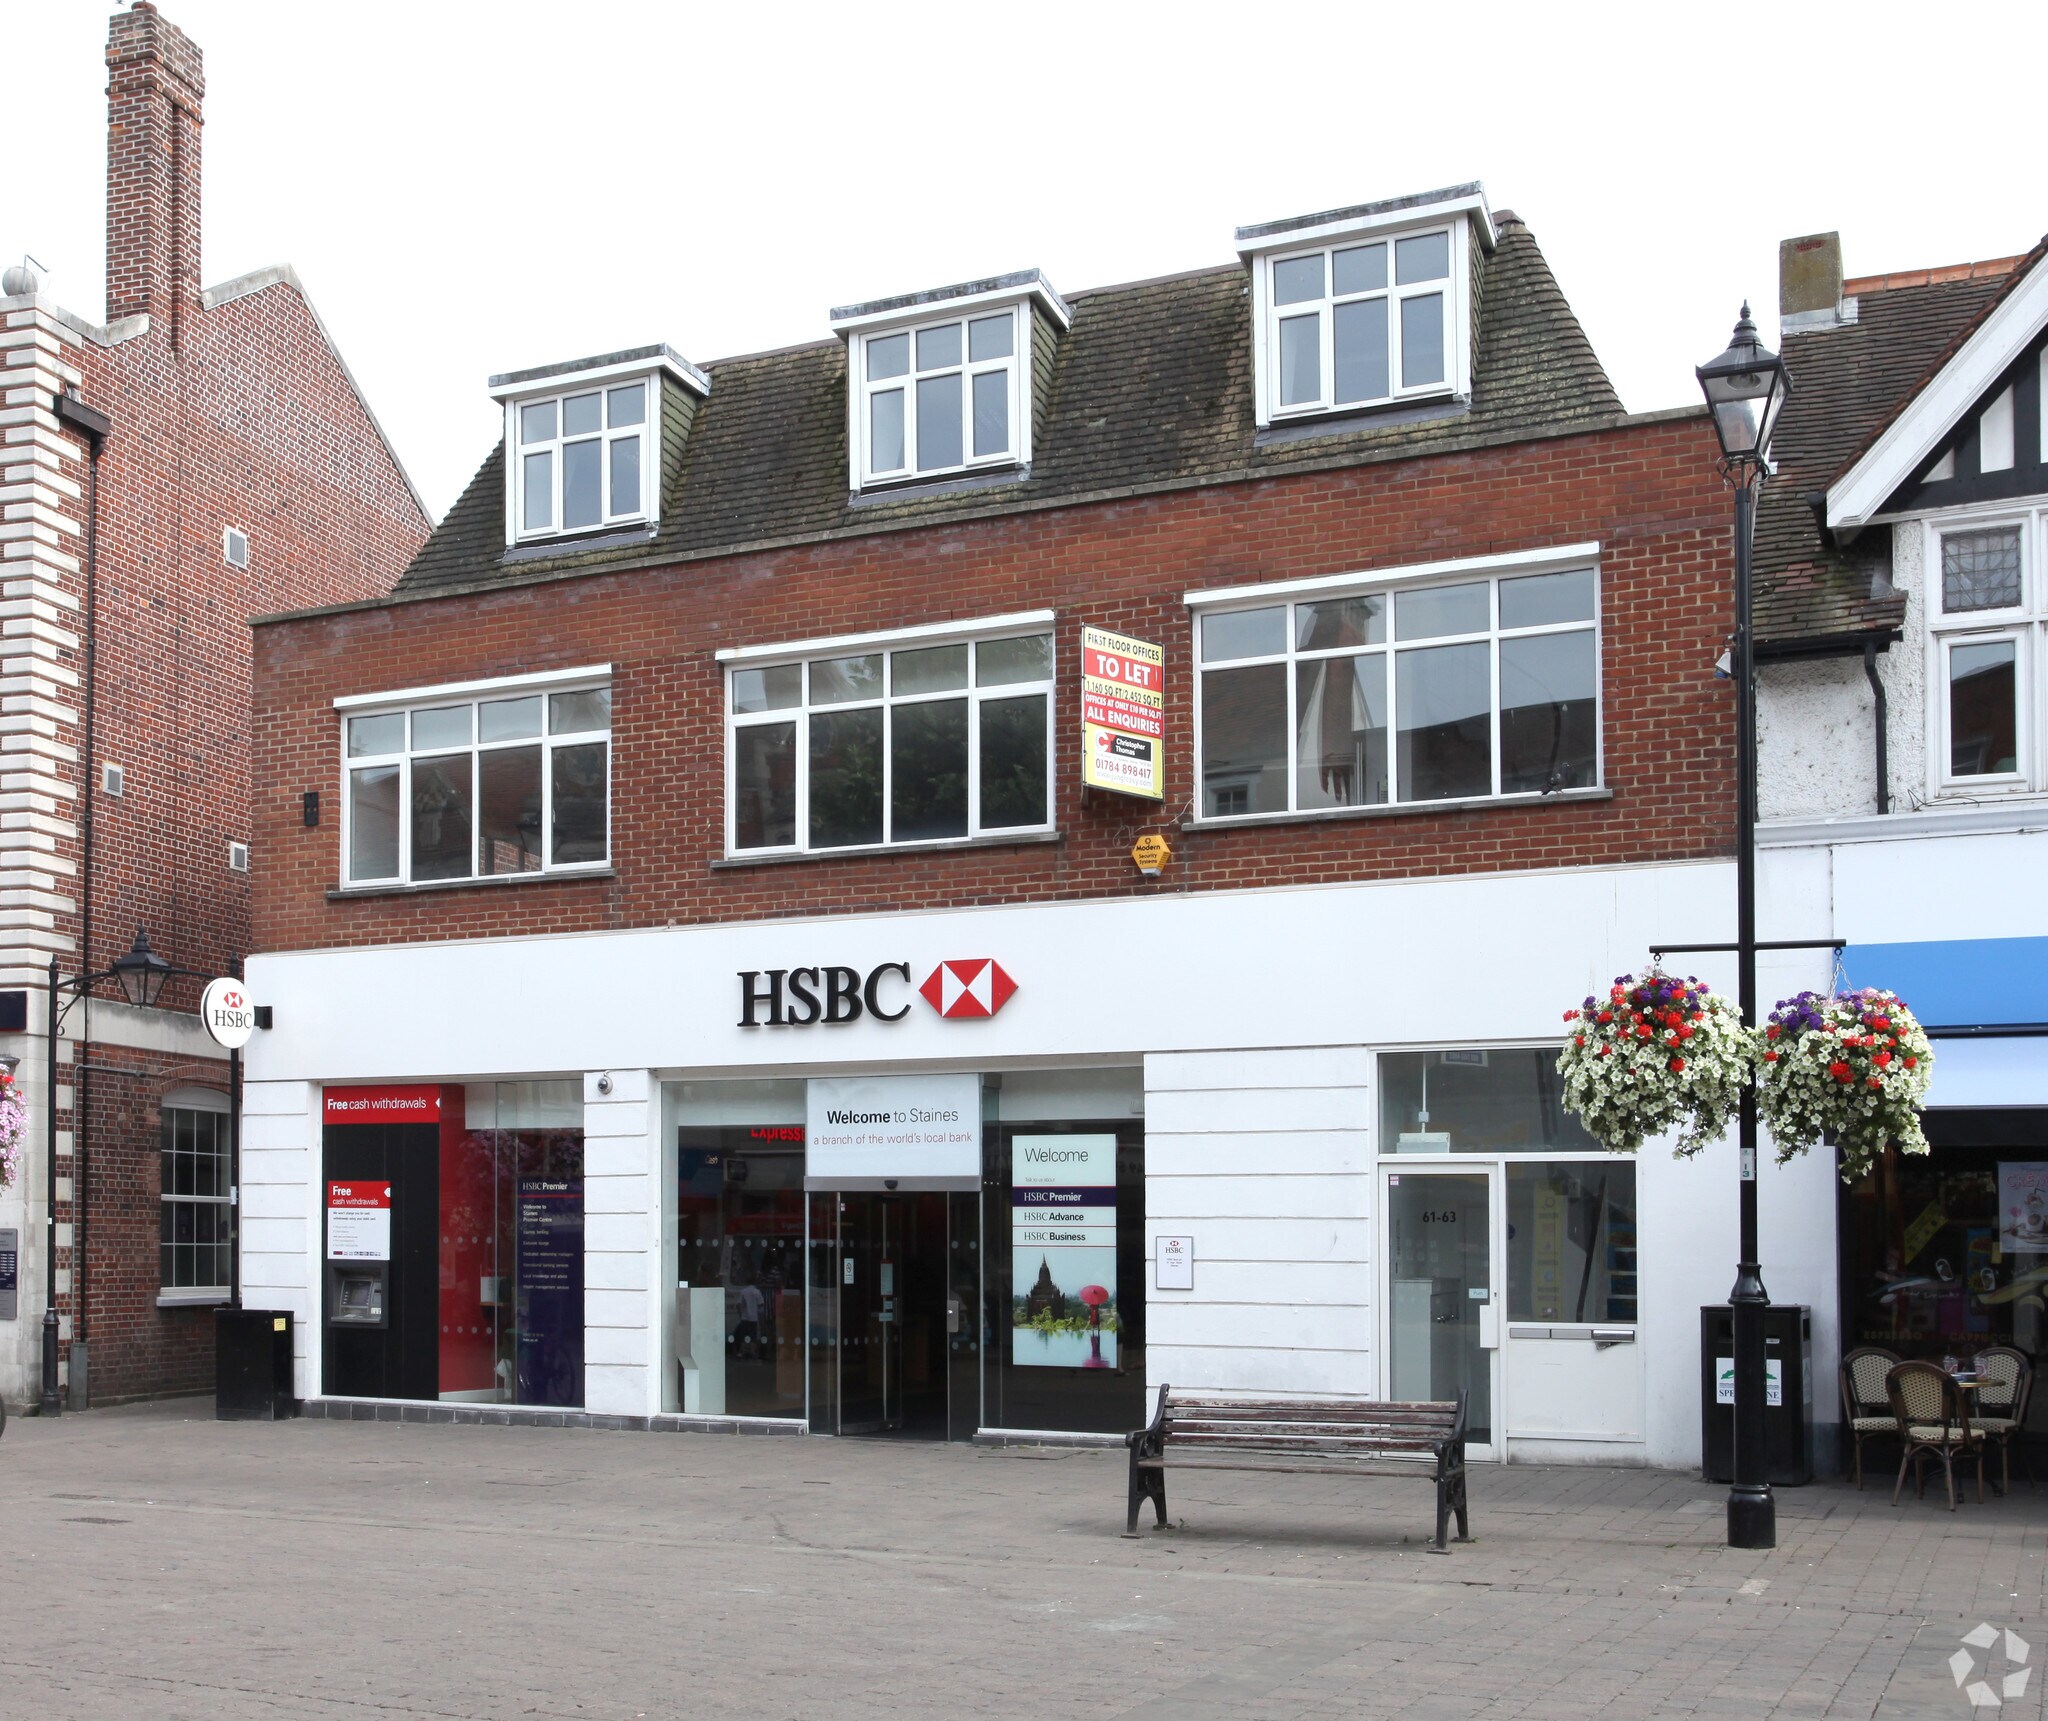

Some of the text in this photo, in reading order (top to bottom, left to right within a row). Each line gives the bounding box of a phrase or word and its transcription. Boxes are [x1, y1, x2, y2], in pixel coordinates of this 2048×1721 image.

[1088, 633, 1160, 661] FIRST FLOOR OFFICES
[1096, 654, 1151, 686] TO LET
[1085, 693, 1107, 706] OFFICES
[1106, 699, 1115, 708] AT
[1114, 701, 1129, 711] ONLY
[1138, 706, 1148, 716] PER
[1087, 705, 1161, 735] ALL ENQUIRIES
[1115, 745, 1136, 756] Thomas
[1116, 737, 1146, 751] Christopher
[1095, 758, 1120, 772] 01784
[1122, 763, 1152, 780] 898417
[737, 962, 912, 1027] HSBC
[214, 1009, 252, 1030] HSBC
[327, 1096, 427, 1110] Free cash withdrawals
[826, 1107, 958, 1124] Welcome to Staines
[813, 1136, 819, 1145] a
[822, 1133, 853, 1145] branch
[855, 1133, 866, 1145] of
[868, 1133, 884, 1144] the
[924, 1131, 946, 1143] local
[949, 1131, 972, 1143] bank
[1025, 1147, 1089, 1162] Welcome
[332, 1185, 352, 1196] Free
[523, 1182, 568, 1190] HSBC Premier
[346, 1197, 379, 1206] withdrawals
[1024, 1192, 1082, 1201] HSBC Premier
[1024, 1212, 1084, 1221] HSBC Advance
[1422, 1211, 1456, 1223] 61-63
[1024, 1232, 1086, 1241] HSBC Business
